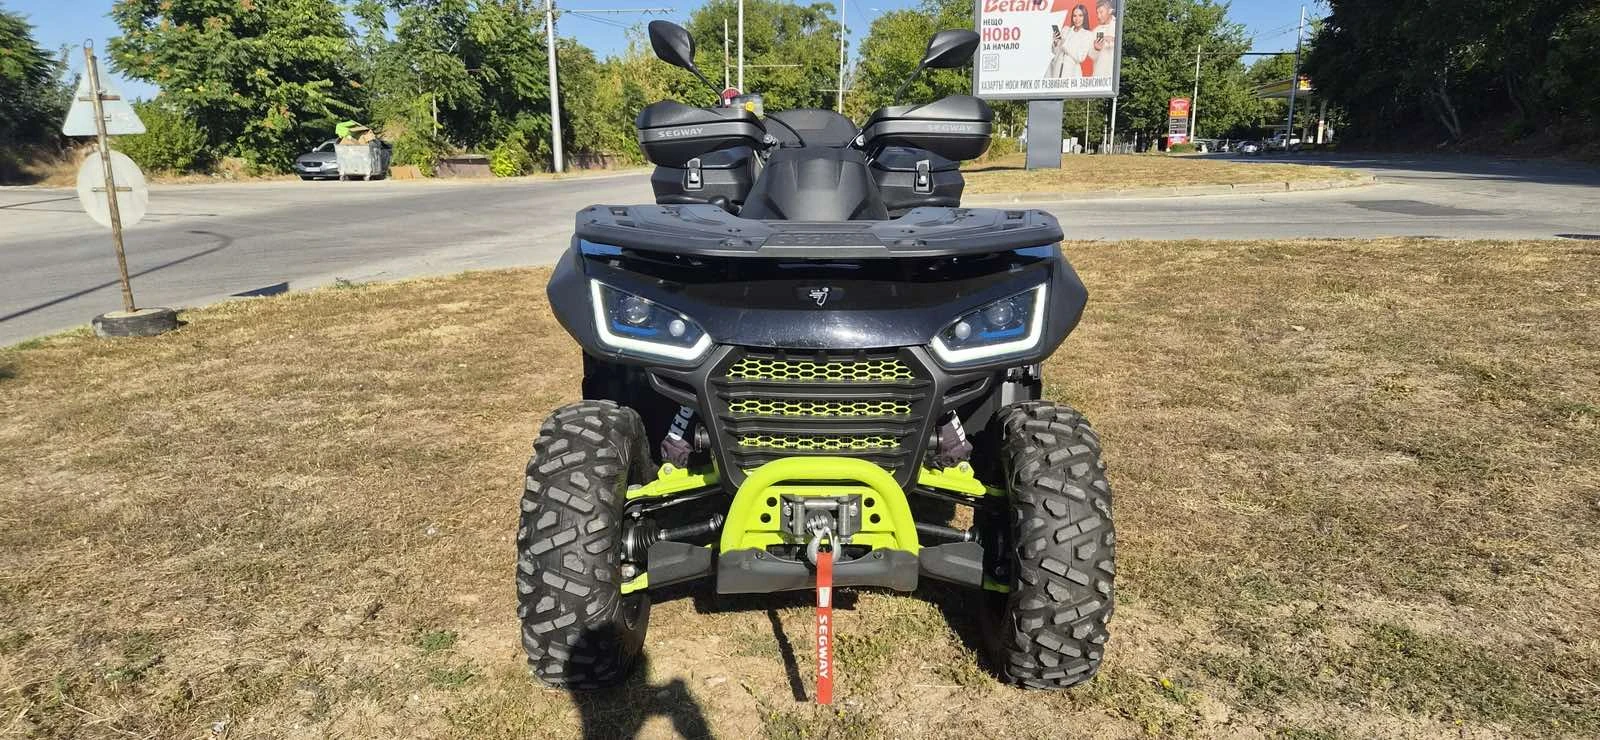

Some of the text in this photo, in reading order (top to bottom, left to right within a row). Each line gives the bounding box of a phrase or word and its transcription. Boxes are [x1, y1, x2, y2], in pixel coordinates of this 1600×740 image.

[983, 18, 1003, 26] НЕЩО
[982, 26, 1021, 41] НОВО
[983, 43, 1020, 51] ЗА НАЧАЛО
[1020, 79, 1033, 89] РИСК
[1033, 79, 1041, 88] ОТ
[1070, 78, 1078, 88] НА
[658, 127, 704, 138] SEGWAY
[927, 124, 974, 132] SEGWAY
[818, 615, 829, 679] SEGWAY
